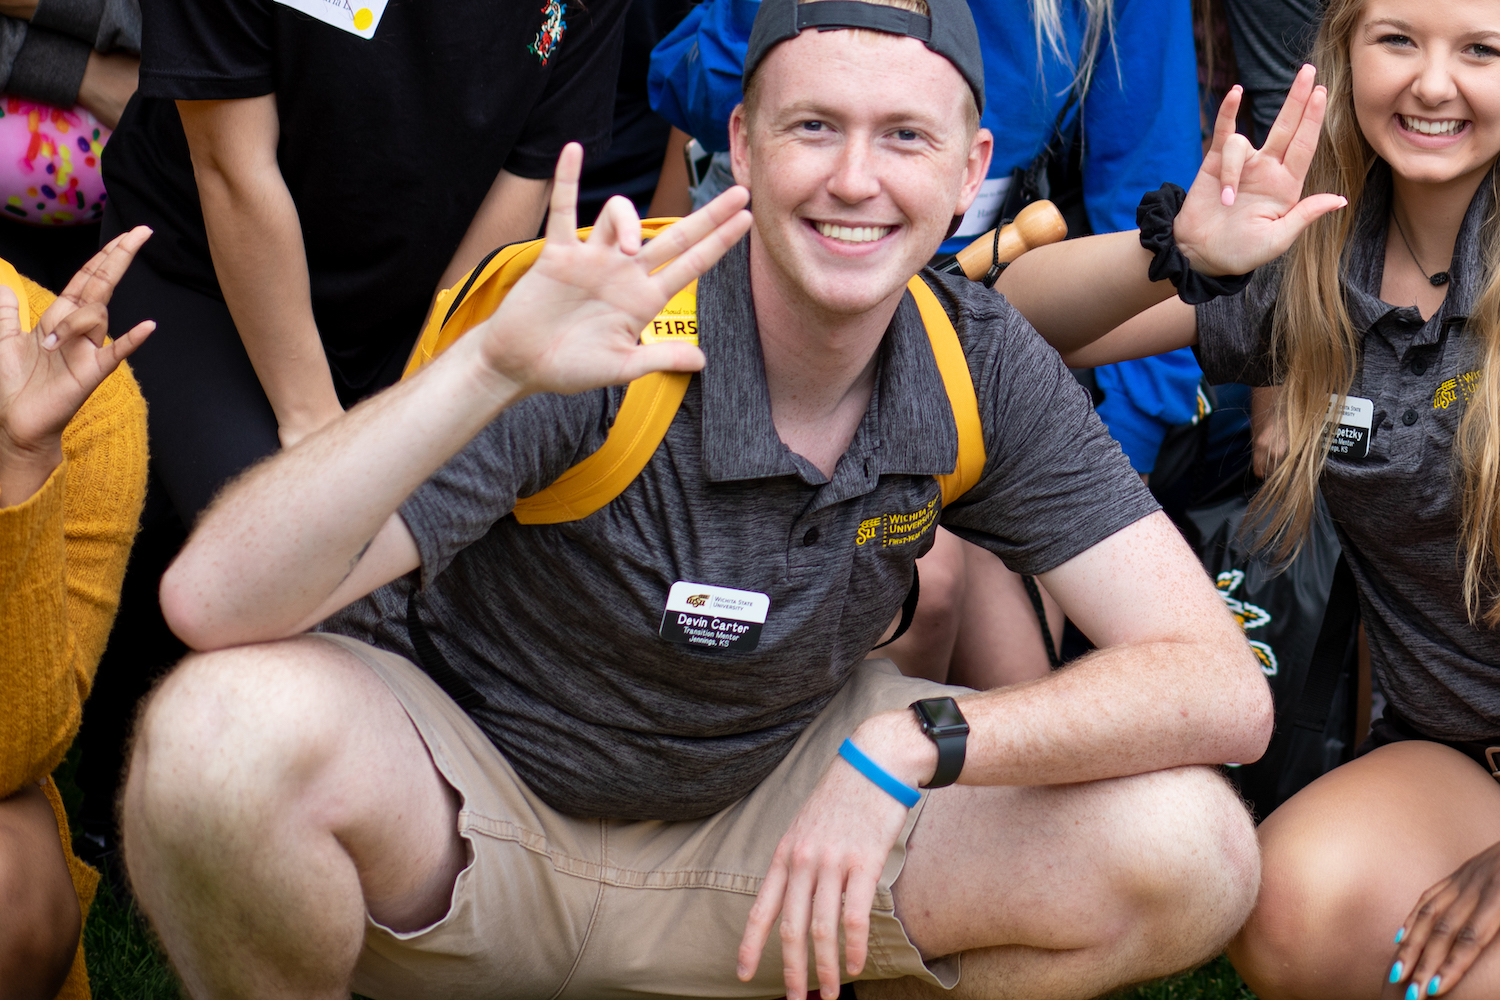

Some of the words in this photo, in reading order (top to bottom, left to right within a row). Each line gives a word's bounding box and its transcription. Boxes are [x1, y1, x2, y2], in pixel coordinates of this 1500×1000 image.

[660, 307, 682, 315] Proud
[653, 321, 698, 335] F1RS
[1336, 428, 1363, 441] petzky
[1340, 446, 1349, 454] KS
[888, 508, 926, 524] WICHITA
[889, 509, 934, 534] UNIVERSITY
[713, 602, 744, 611] UNIVERSITY
[714, 596, 737, 604] WICHITA
[738, 599, 753, 607] STATE
[677, 613, 708, 628] Devin
[711, 619, 750, 634] Carter
[683, 626, 715, 637] Transition
[715, 631, 740, 642] Mentor
[688, 635, 718, 647] Jennings,
[718, 639, 730, 648] KS
